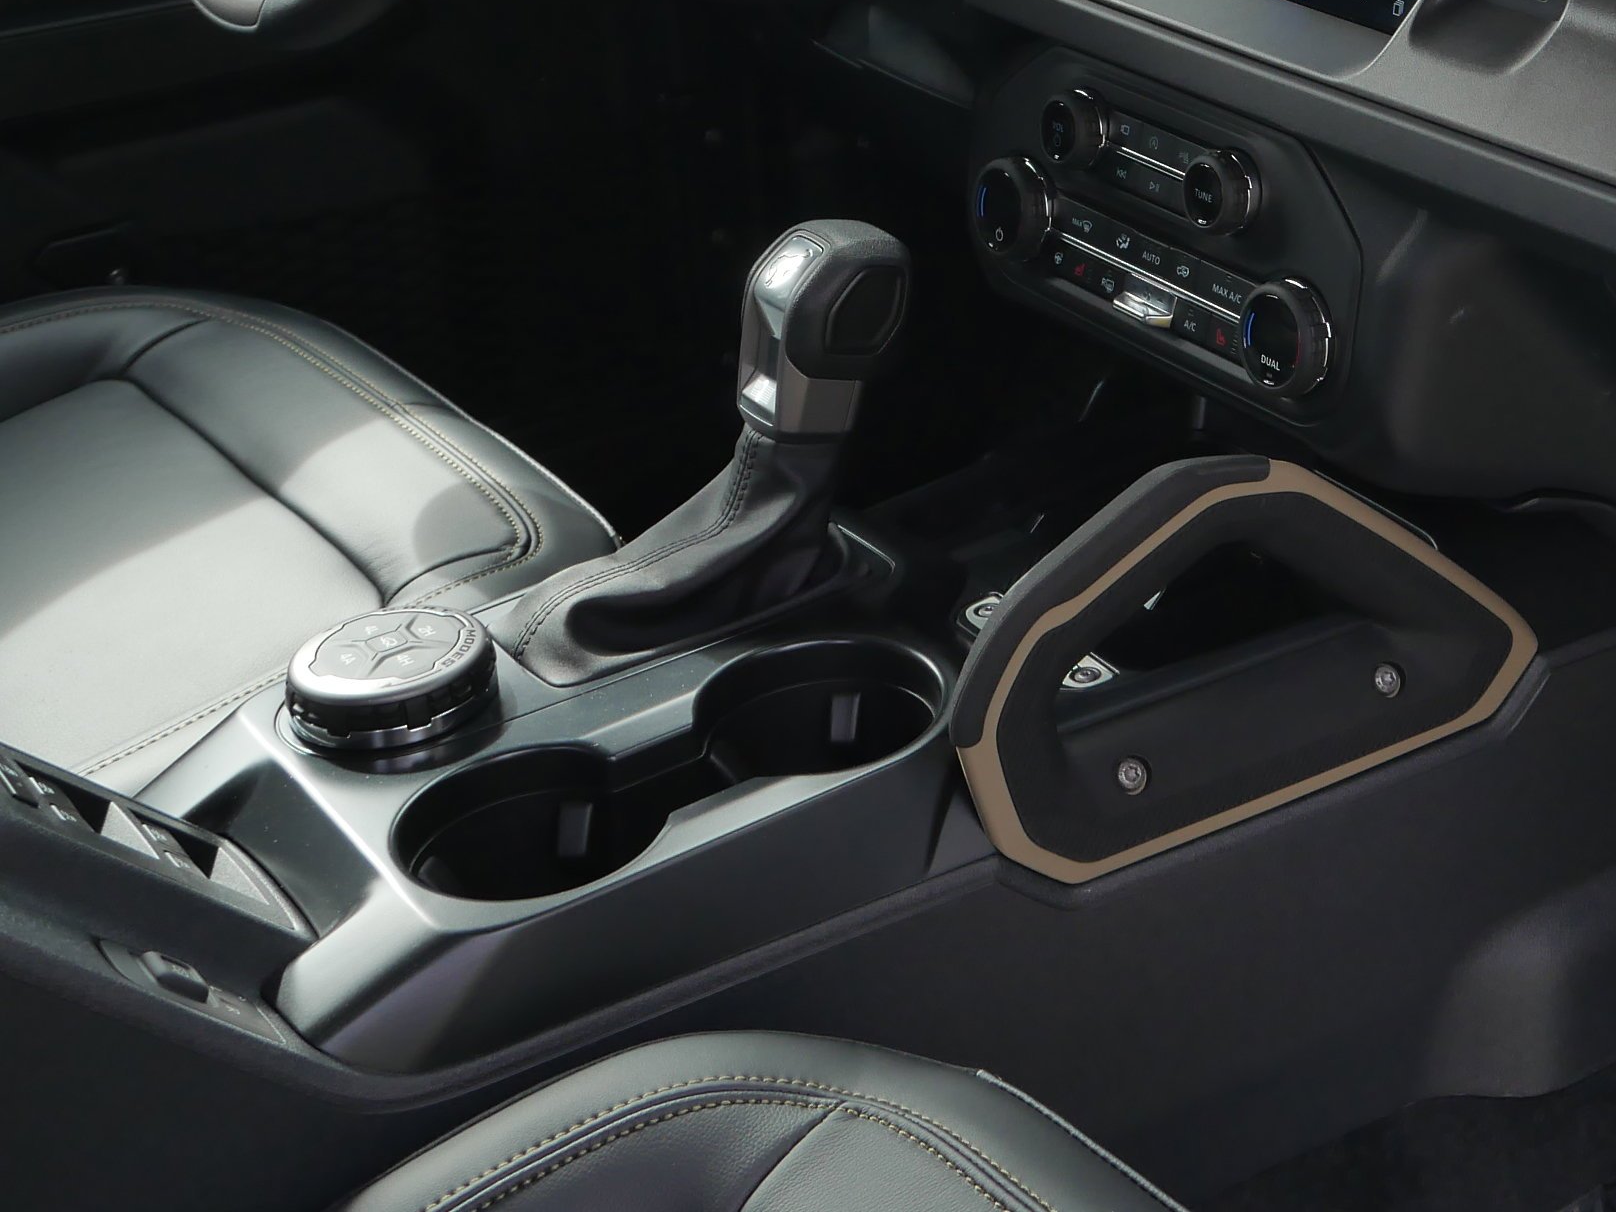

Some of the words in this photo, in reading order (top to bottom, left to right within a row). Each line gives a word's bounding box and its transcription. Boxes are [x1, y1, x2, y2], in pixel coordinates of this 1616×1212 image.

[1194, 188, 1213, 203] TUNE
[1142, 250, 1161, 265] AUTO
[1212, 283, 1228, 298] MAX
[1229, 291, 1241, 305] A/C
[1184, 319, 1196, 331] A/C
[1261, 354, 1280, 371] DUAL
[442, 629, 476, 668] MODES
